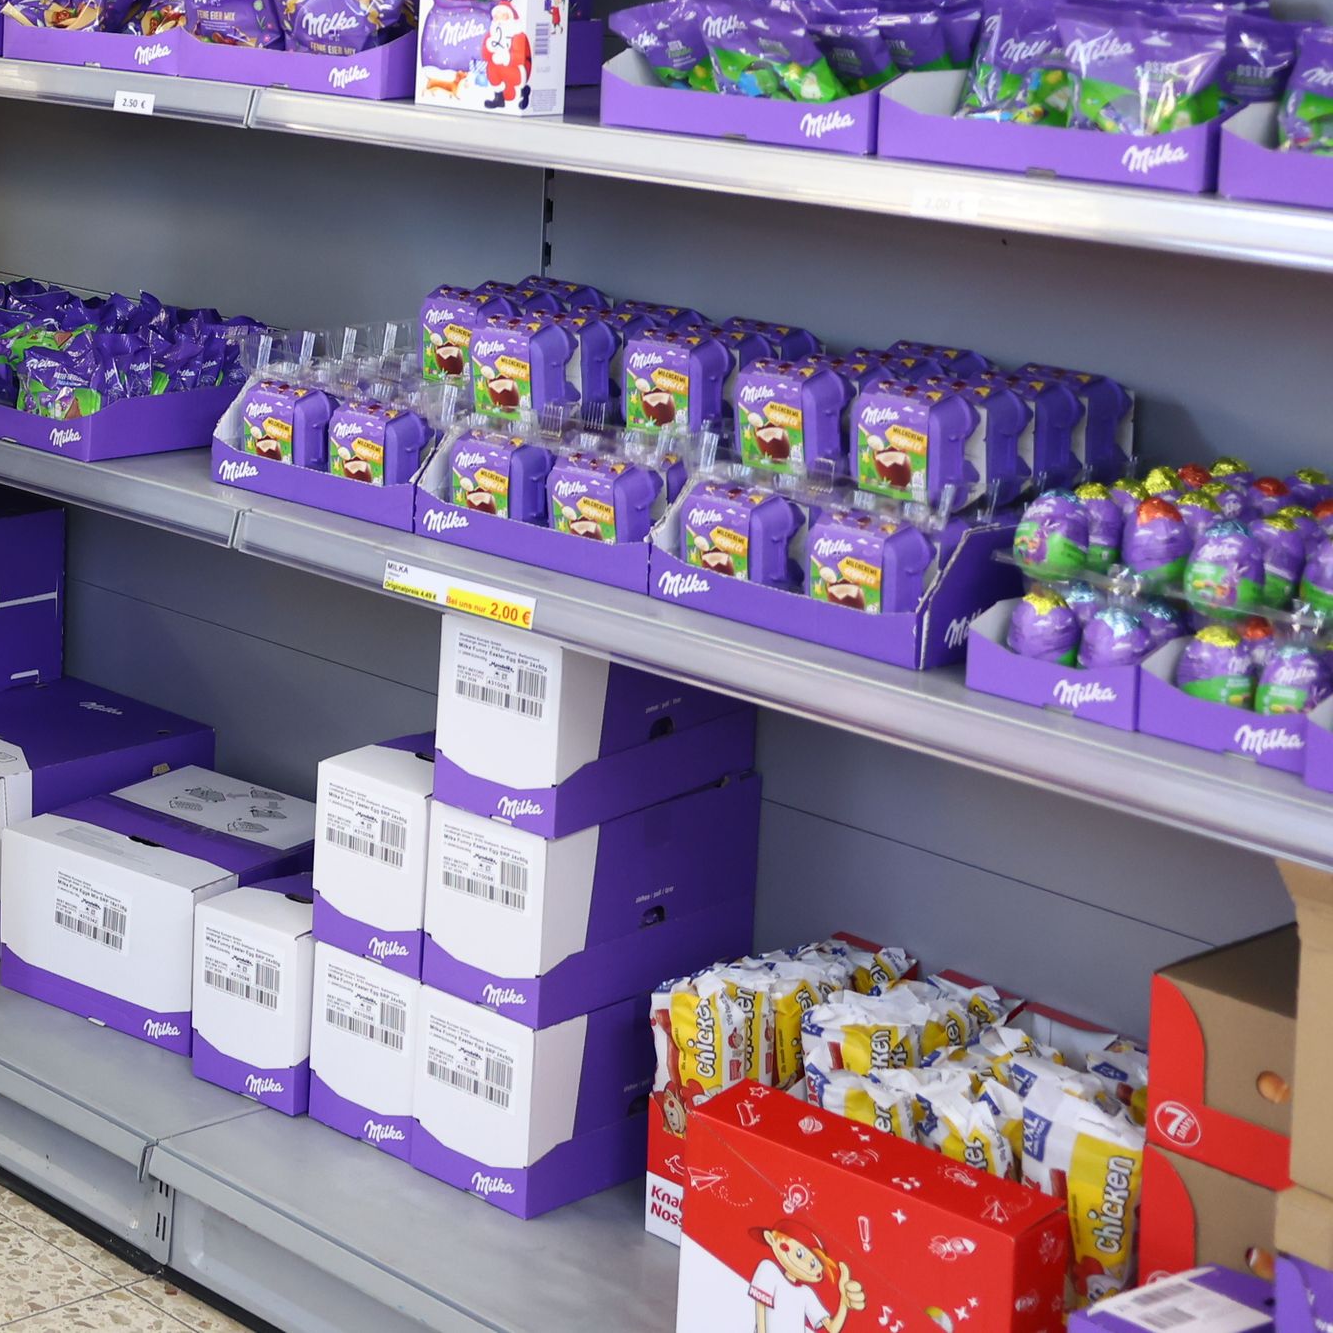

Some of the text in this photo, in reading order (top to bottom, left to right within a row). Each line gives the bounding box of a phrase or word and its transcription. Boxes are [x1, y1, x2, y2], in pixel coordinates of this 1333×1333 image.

[301, 11, 359, 38] Milka
[439, 21, 486, 45] Milka
[134, 42, 172, 65] Milka
[1064, 38, 1134, 65] Milka
[329, 66, 370, 88] Milka
[122, 98, 138, 109] 2.50
[800, 111, 855, 139] Milka
[1122, 143, 1189, 174] Milka
[426, 308, 455, 323] Milka
[474, 339, 506, 356] Milka
[629, 352, 663, 369] Milka
[740, 385, 775, 402] Milka
[245, 402, 273, 417] Milka
[861, 406, 900, 424] Milka
[49, 427, 82, 449] Milka
[333, 422, 363, 438] Milka
[218, 459, 259, 482] Milka
[455, 451, 486, 467] Milka
[554, 479, 588, 496] Milka
[423, 510, 469, 534] Milka
[688, 508, 724, 525] Milka
[814, 537, 852, 555] Milka
[387, 562, 409, 575] MILKA
[384, 580, 420, 596] Originalpreis
[659, 570, 711, 597] Milka
[445, 595, 532, 625] Bei uns nur 2,00 €
[1054, 678, 1117, 708] Milka
[1234, 724, 1305, 755] Milka
[497, 795, 544, 821] Milka
[368, 936, 409, 961] Milka
[482, 982, 526, 1008] Milka
[143, 1017, 181, 1041] Milka
[245, 1072, 284, 1096] Milka
[363, 1118, 405, 1143] Milka
[471, 1170, 515, 1196] Milka
[1095, 1154, 1136, 1255] chicken
